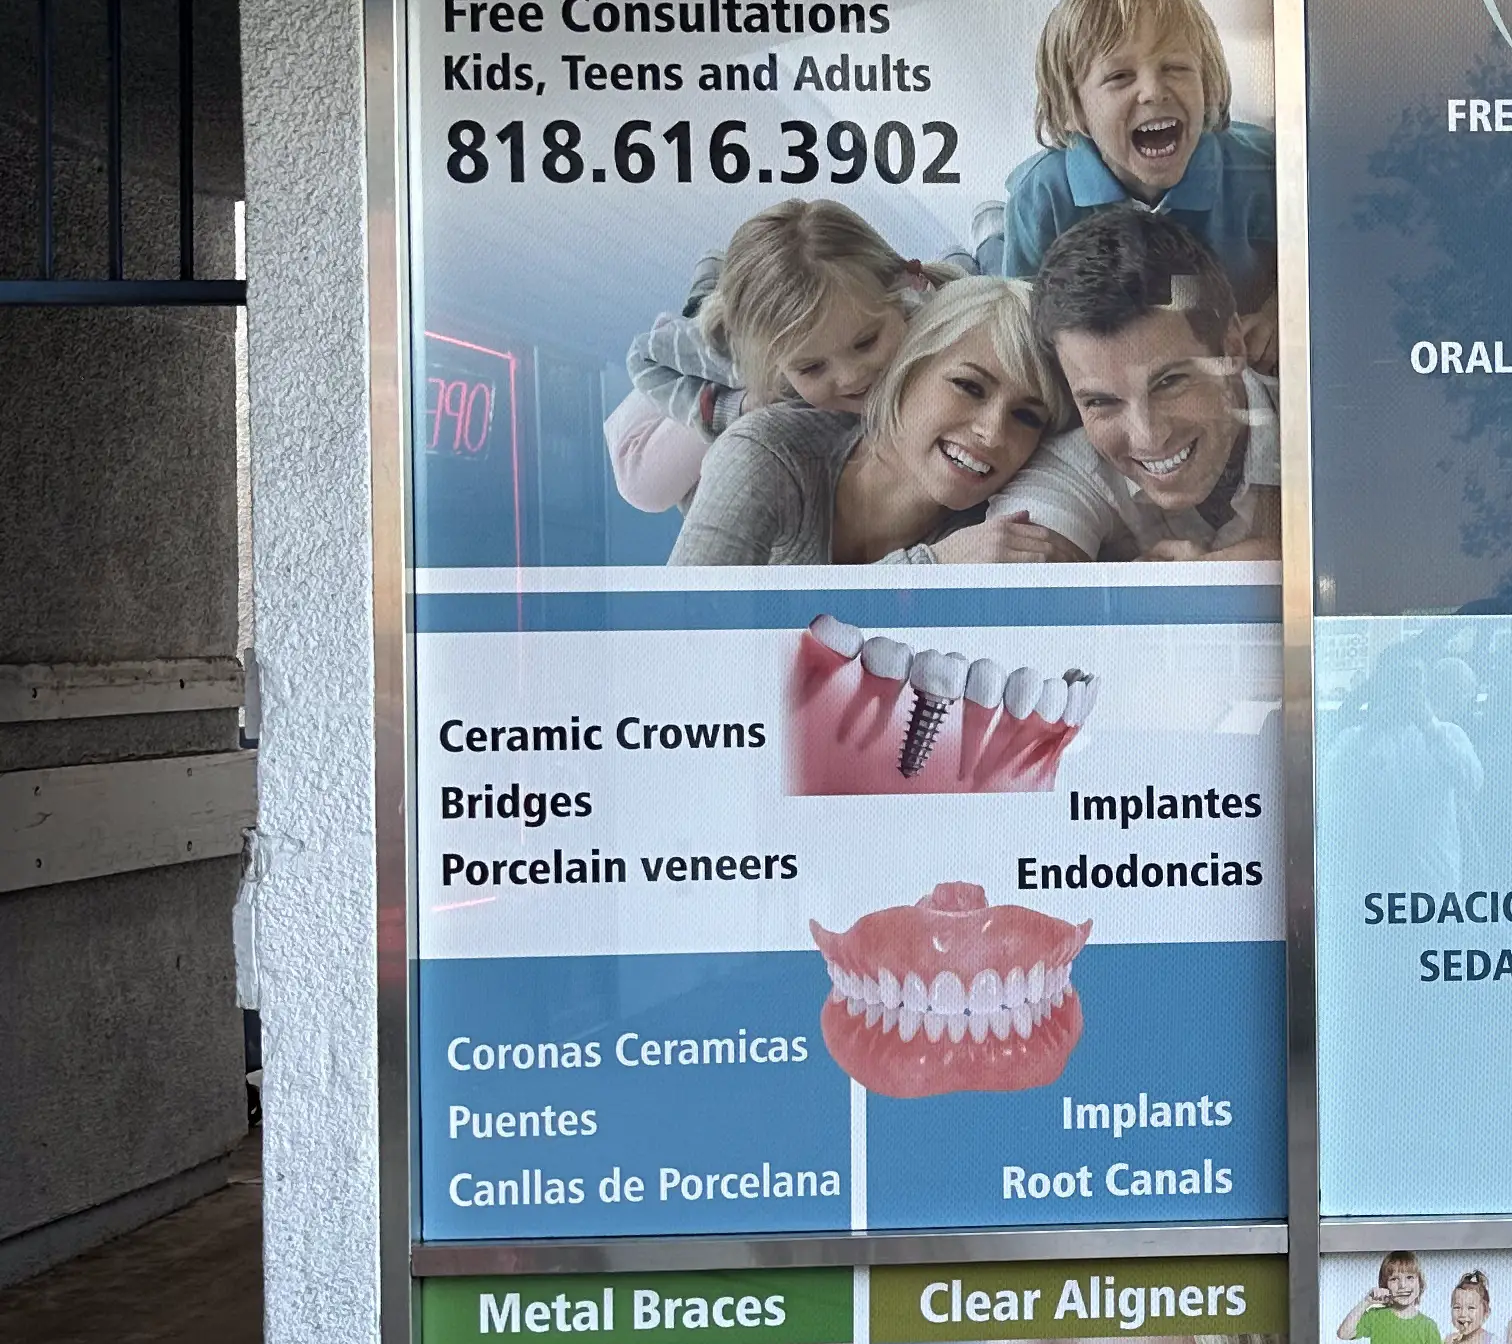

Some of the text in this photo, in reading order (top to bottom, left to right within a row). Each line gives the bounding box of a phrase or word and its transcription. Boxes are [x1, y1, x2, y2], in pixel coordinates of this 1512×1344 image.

[445, 53, 931, 95] Kids, Teens and Adults
[447, 120, 960, 184] 818.616.3902
[1411, 341, 1512, 374] ORAL
[440, 716, 765, 752] Ceramic Crowns
[442, 783, 592, 827] Bridges
[1071, 785, 1262, 829] Implantes
[443, 849, 797, 885] Porcelain veneers
[1018, 854, 1263, 889] Endodoncias
[448, 1033, 807, 1070] Coronas Ceramicas
[450, 1106, 597, 1138] Puentes
[1063, 1093, 1232, 1137] Implants
[449, 1163, 840, 1206] Canllas de Porcelana
[1003, 1159, 1232, 1198] Root Canals
[480, 1288, 785, 1333] Metal Braces
[921, 1276, 1246, 1329] Clear Aligners
